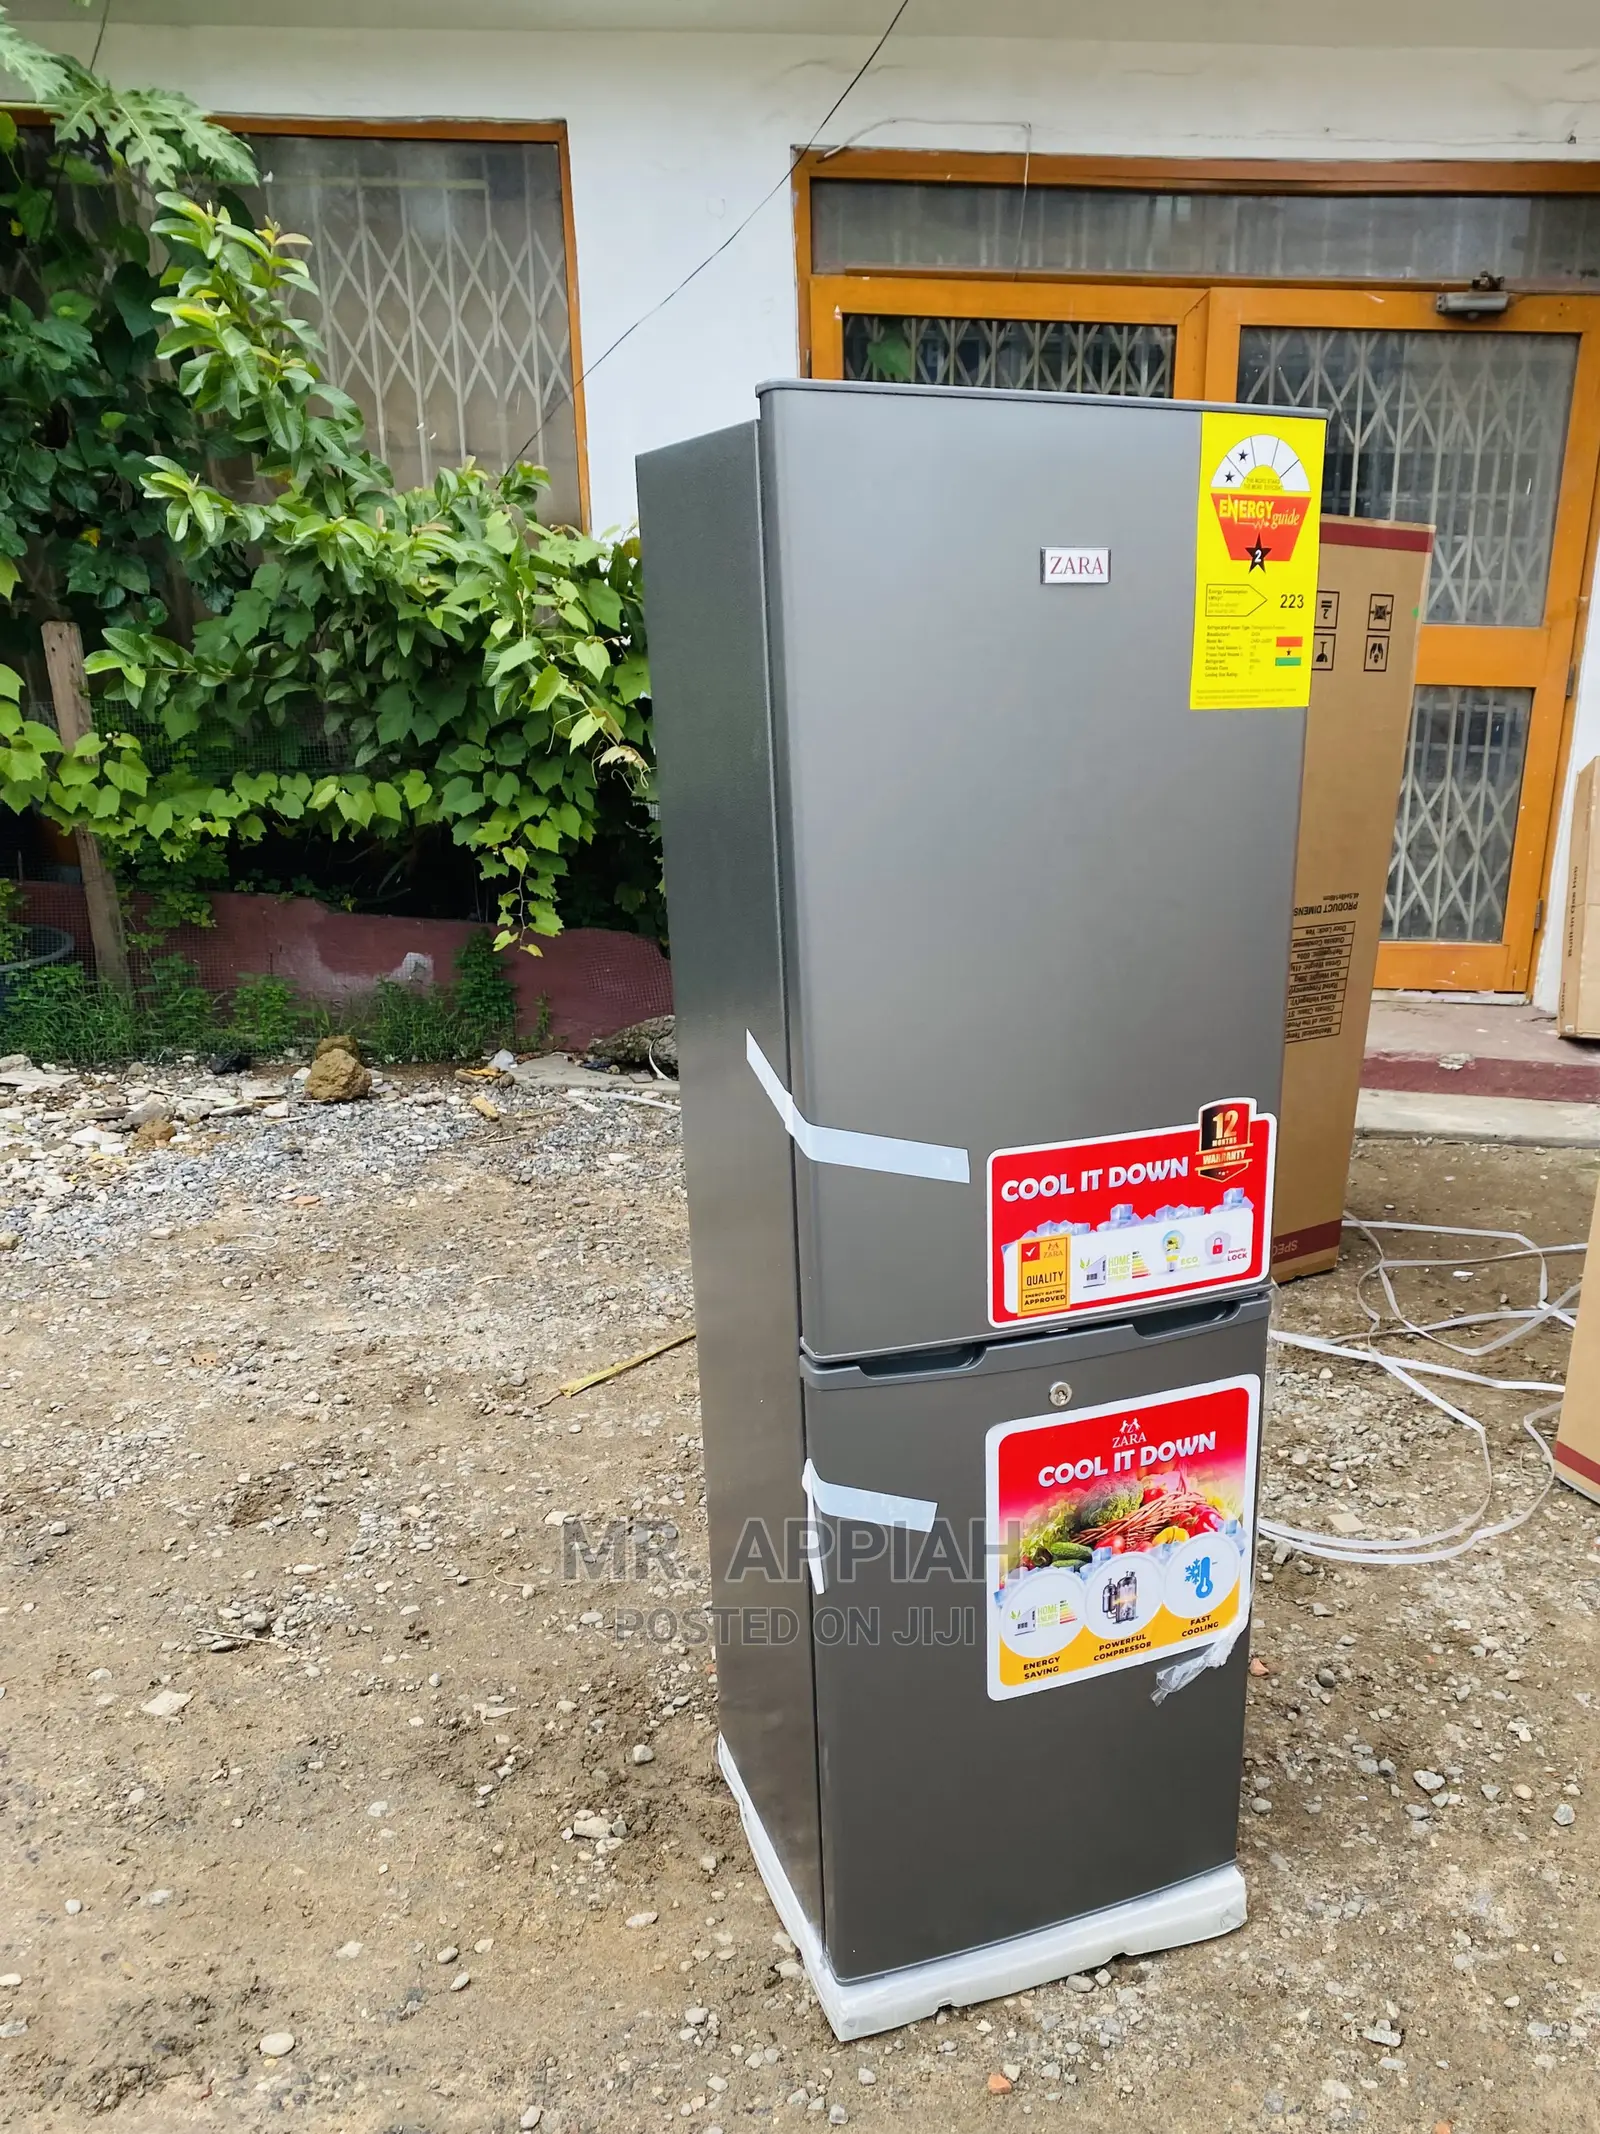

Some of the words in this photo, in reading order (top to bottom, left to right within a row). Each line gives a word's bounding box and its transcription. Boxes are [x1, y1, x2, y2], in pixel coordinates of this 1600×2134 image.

[1219, 495, 1274, 524] ENERGY
[1270, 508, 1300, 530] guide
[1254, 549, 1262, 562] 2
[1050, 556, 1104, 575] ZARA
[1280, 594, 1304, 608] 223
[1323, 901, 1359, 914] PRODUCT
[1212, 1110, 1239, 1139] 12
[1212, 1137, 1237, 1147] MONTHS
[1203, 1149, 1246, 1165] WARRANTY
[1000, 1175, 1075, 1202] COOL
[1080, 1168, 1103, 1192] IT
[1108, 1156, 1189, 1188] DOWN
[1043, 1250, 1064, 1259] ZARA
[1108, 1254, 1131, 1267] HOME
[1181, 1256, 1199, 1265] ECO
[1227, 1252, 1248, 1262] LOCK
[1026, 1271, 1064, 1286] QUALITY
[1024, 1294, 1066, 1306] APPROVED
[1025, 1291, 1045, 1299] ENERGY
[1112, 1431, 1147, 1449] ZARA
[1038, 1456, 1108, 1487] COOL
[1114, 1449, 1135, 1473] IT
[1140, 1431, 1217, 1467] DOWN
[1037, 1603, 1059, 1615] HOME
[1190, 1614, 1212, 1626] FAST
[1181, 1622, 1219, 1637] COOLING
[1099, 1634, 1147, 1652] POWERFUL
[1093, 1641, 1152, 1662] COMPRESSOR
[1023, 1656, 1060, 1671] ENERGY
[1024, 1666, 1060, 1680] SAVING
